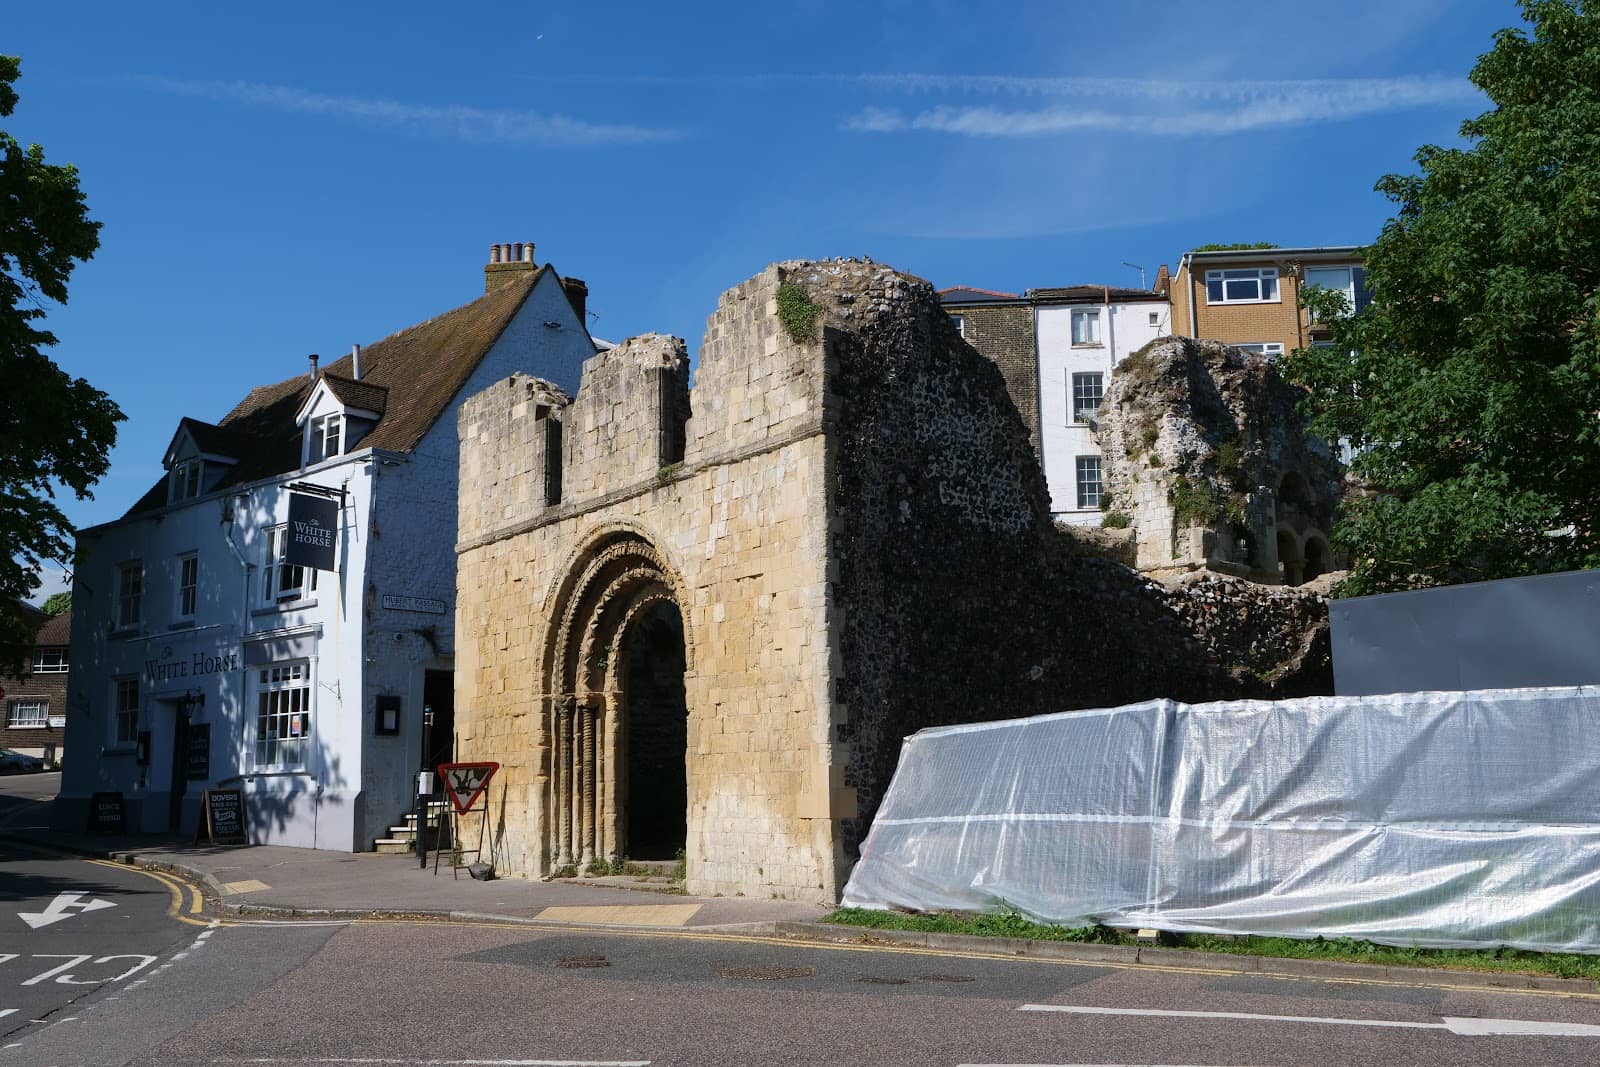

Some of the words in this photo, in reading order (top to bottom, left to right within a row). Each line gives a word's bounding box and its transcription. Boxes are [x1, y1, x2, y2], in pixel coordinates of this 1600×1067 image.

[294, 521, 332, 538] WHITE
[295, 534, 331, 547] HORSE
[145, 659, 188, 681] WHITE
[192, 652, 238, 676] HORSE
